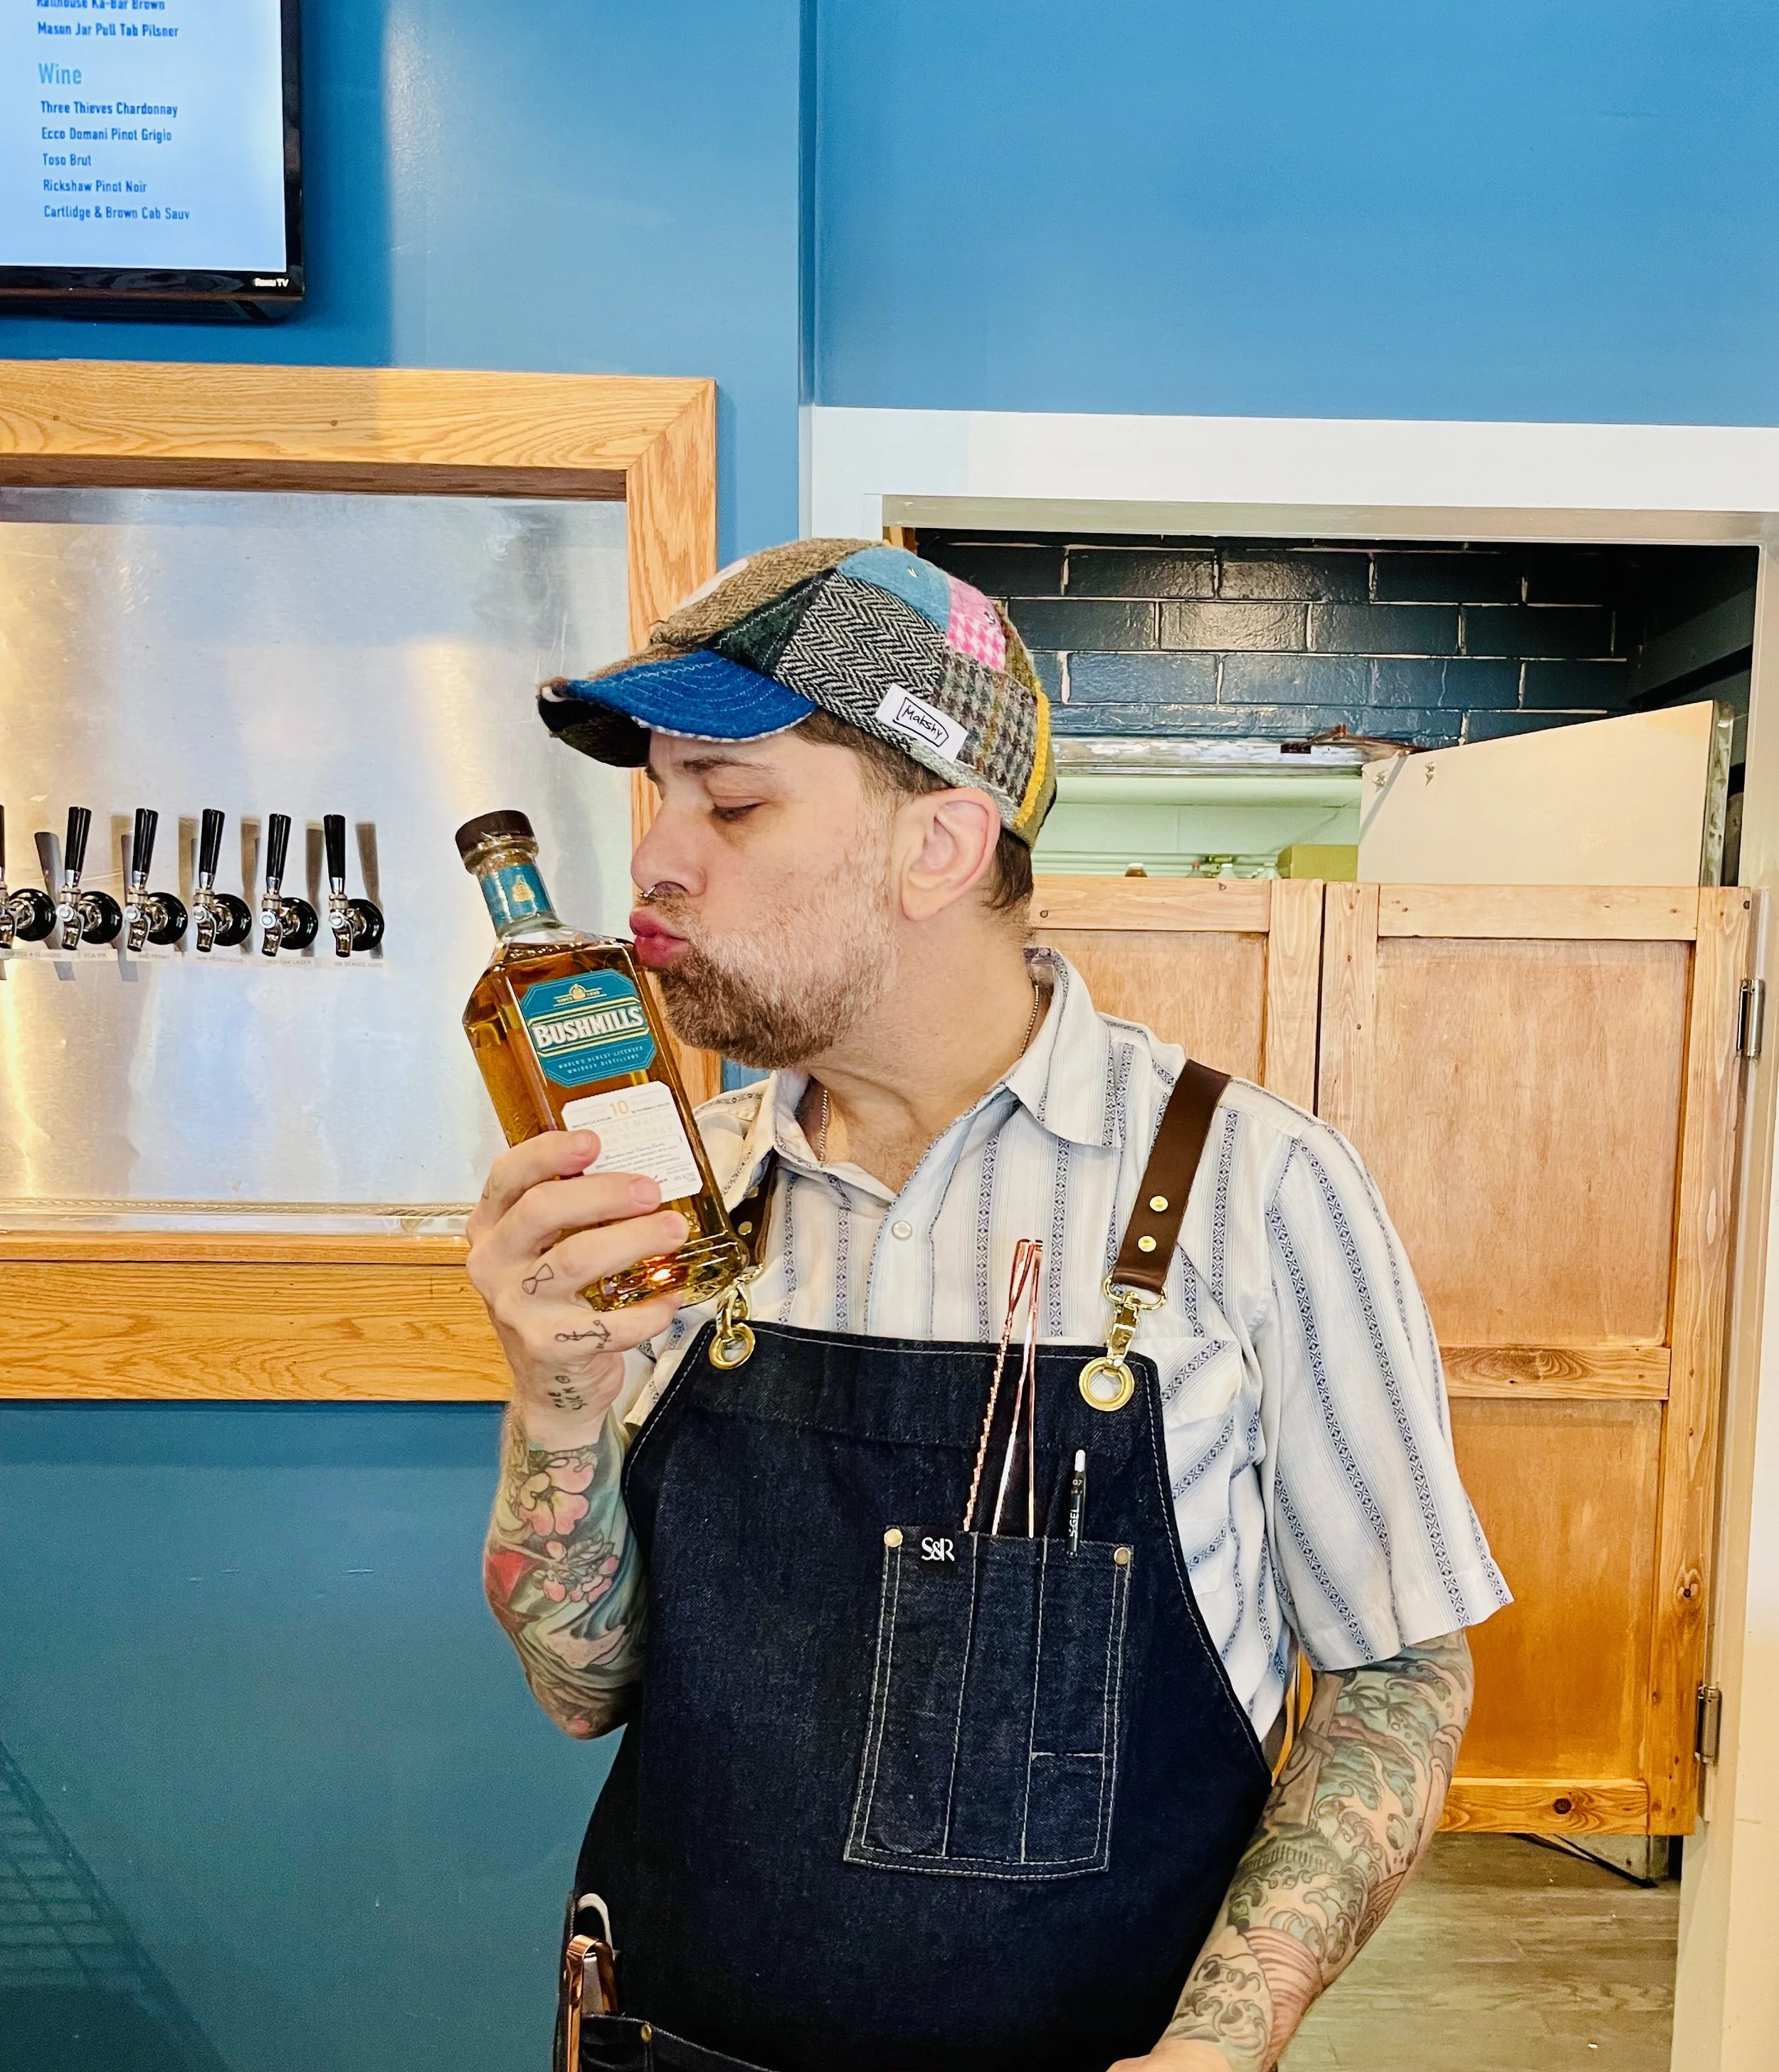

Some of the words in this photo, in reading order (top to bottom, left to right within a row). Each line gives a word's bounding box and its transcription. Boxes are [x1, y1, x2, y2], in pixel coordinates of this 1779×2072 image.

[132, 0, 164, 10] Brown
[38, 21, 71, 35] Mason
[75, 23, 92, 36] Jar
[95, 23, 116, 36] Pull
[120, 23, 138, 36] Tab
[142, 23, 179, 37] Pilsner
[38, 62, 82, 85] Wine
[41, 100, 70, 114] Three
[73, 101, 112, 115] Thieves
[116, 102, 178, 118] Chardonnay
[41, 127, 65, 139] Ecco
[70, 127, 107, 140] Domani
[111, 128, 137, 140] Pinot
[142, 129, 171, 144] Grigio
[43, 153, 66, 166] Toso
[70, 153, 92, 166] Brut
[43, 179, 92, 192] Rickshaw
[95, 179, 122, 192] Pinot
[125, 181, 147, 193] Noir
[44, 205, 90, 221] Cartlidge
[94, 206, 102, 218] &
[106, 206, 138, 219] Brown
[142, 207, 161, 219] Cab
[165, 207, 190, 220] Sauv
[276, 278, 289, 287] TV
[901, 704, 944, 740] Makshy
[532, 1005, 643, 1048] BUSHMILLS
[558, 1059, 586, 1069] WORLD'S
[587, 1052, 611, 1062] OLDEST
[600, 1053, 640, 1067] DISTILLERY
[609, 1100, 630, 1116] 10
[921, 1536, 955, 1562] S&R
